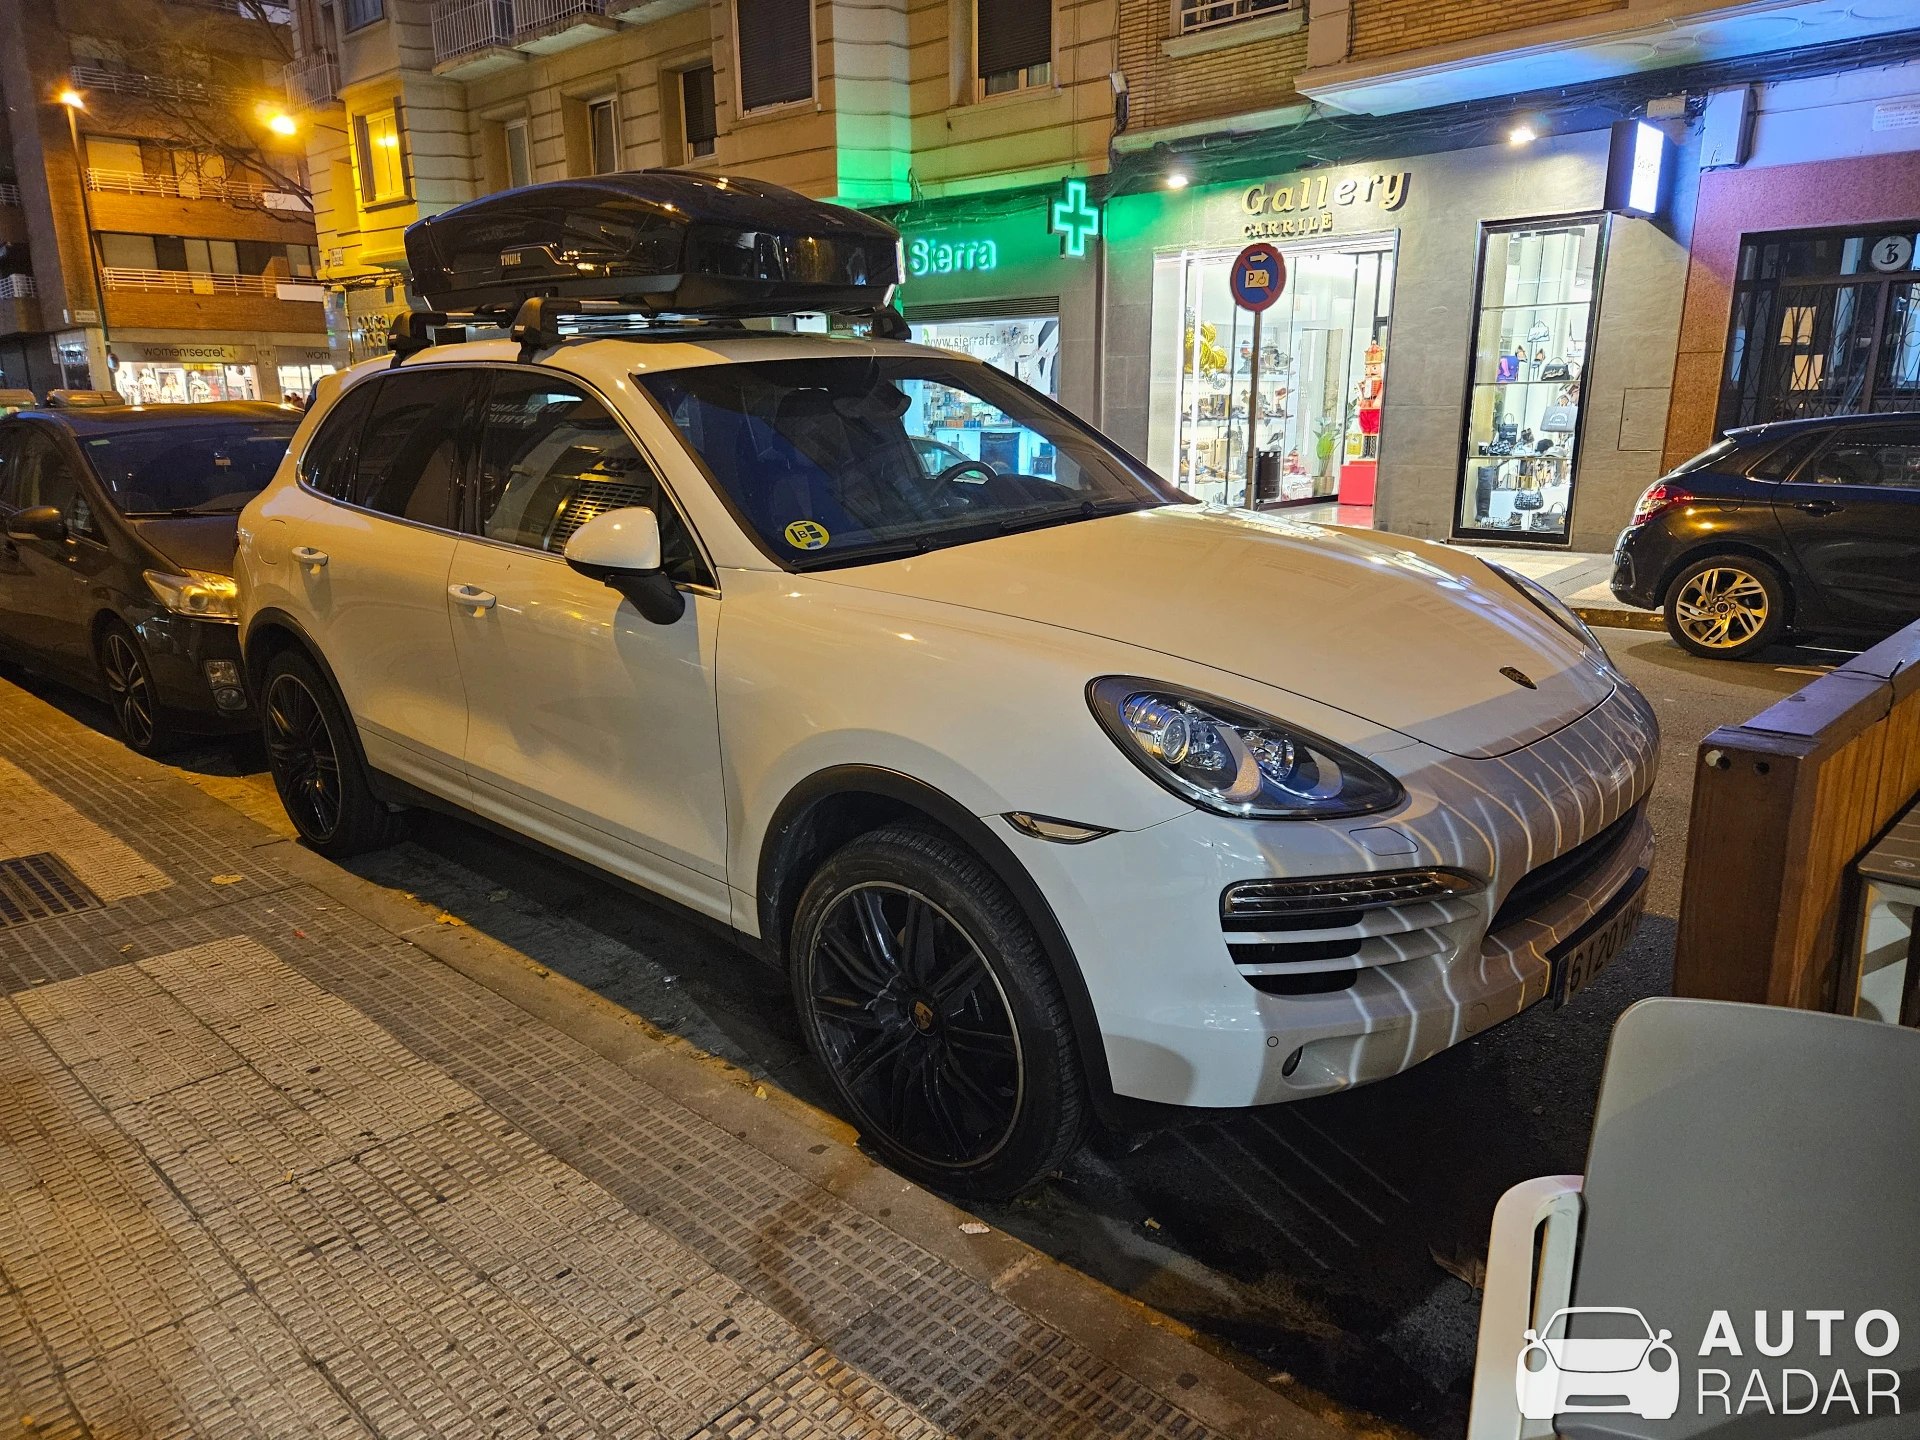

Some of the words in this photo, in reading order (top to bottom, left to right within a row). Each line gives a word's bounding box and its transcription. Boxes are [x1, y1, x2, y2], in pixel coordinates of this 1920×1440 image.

[1241, 173, 1406, 214] Gallery
[500, 252, 522, 266] THULE
[908, 239, 997, 276] Sierra
[1880, 243, 1900, 265] 3
[1247, 272, 1255, 286] P
[305, 352, 331, 360] wom
[1570, 921, 1619, 992] 6120
